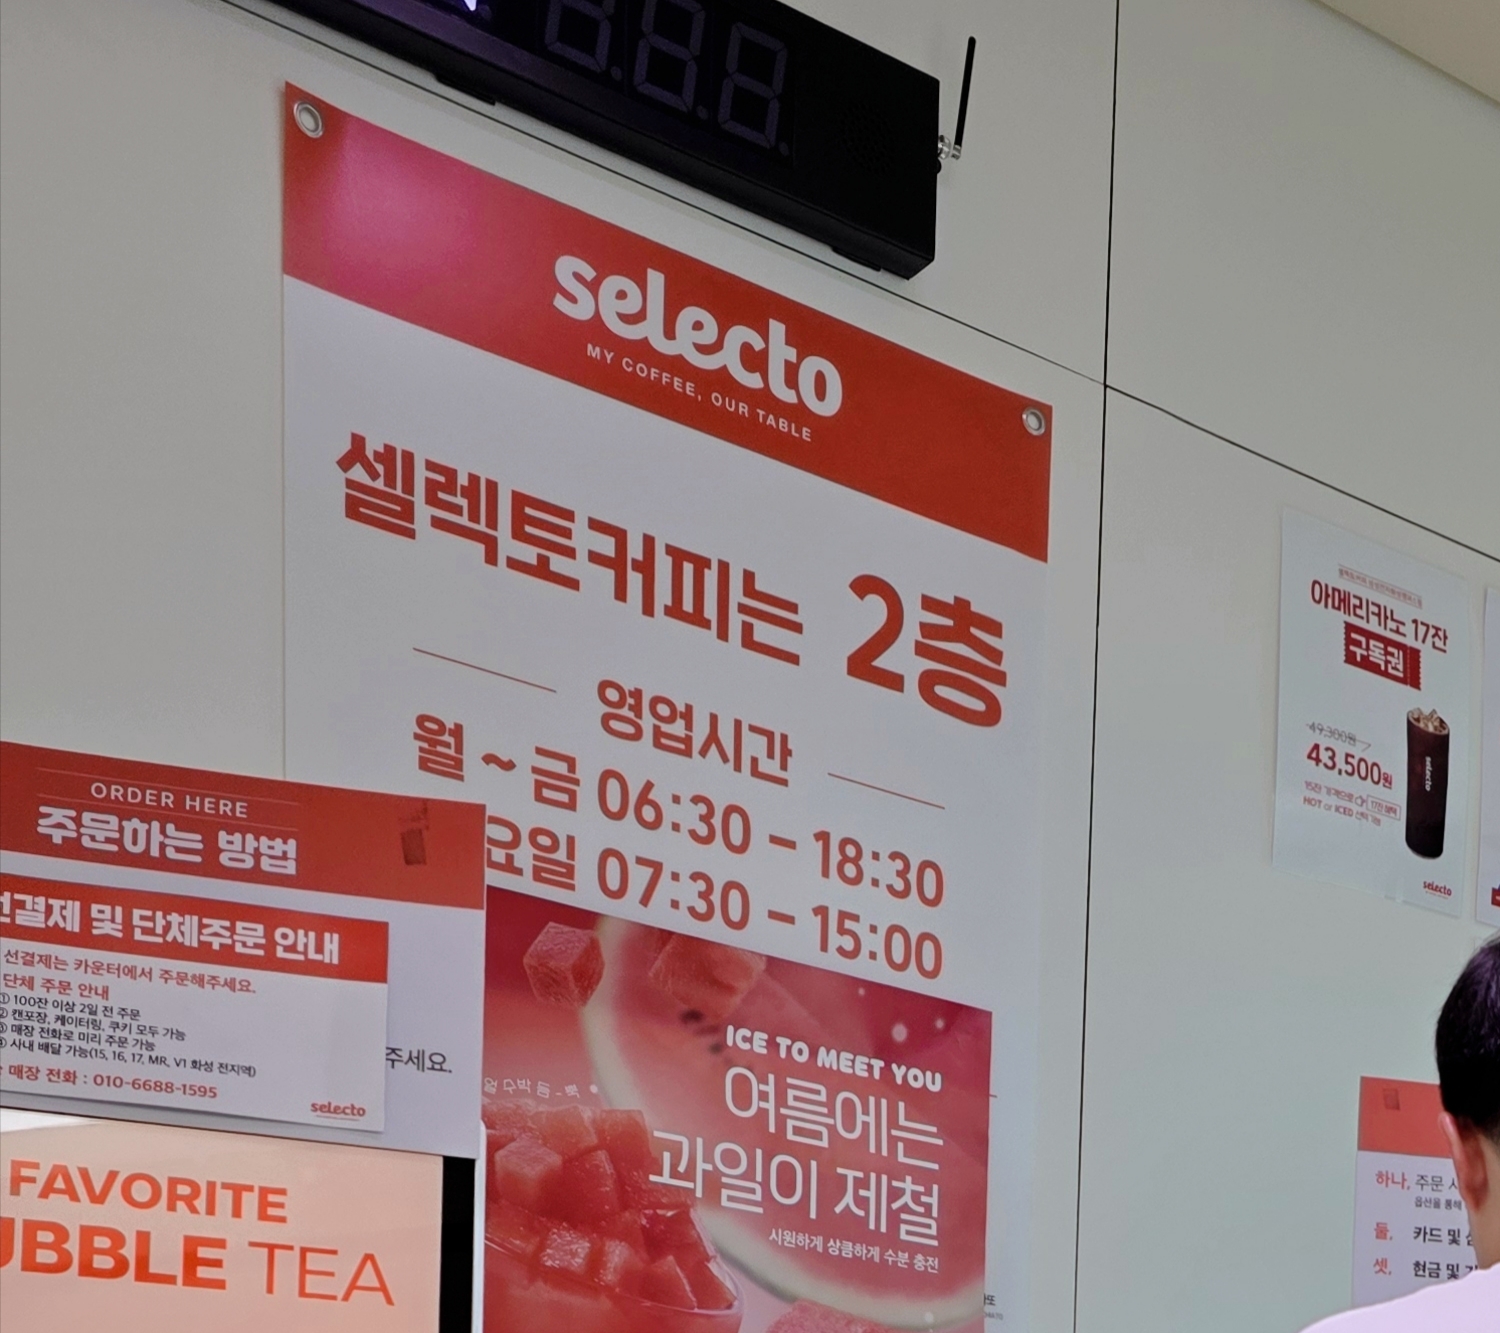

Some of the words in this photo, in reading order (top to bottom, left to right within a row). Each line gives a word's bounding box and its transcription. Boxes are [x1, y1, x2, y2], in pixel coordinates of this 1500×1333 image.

[553, 254, 843, 417] selecto
[587, 343, 615, 364] MY
[622, 356, 702, 402] COFFEE,
[711, 392, 749, 418] OUR
[757, 408, 812, 442] TABLE
[337, 431, 803, 667] 셀렉토커피는
[846, 573, 1007, 728] 2층
[1311, 579, 1407, 638] 아메리카노
[1411, 618, 1448, 653] 17잔
[1349, 632, 1404, 678] 구독권
[597, 679, 792, 787] 영업시간
[1306, 742, 1393, 790] 43,500원
[91, 782, 174, 808] ORDER
[185, 795, 248, 818] HERE
[37, 806, 204, 863] 주문하는
[218, 830, 297, 875] 방법
[597, 769, 752, 855] 06:30
[812, 829, 944, 908] 18:30
[1423, 880, 1452, 896] selecto
[90, 903, 123, 938] 및
[131, 908, 267, 957] 단체주문
[274, 927, 340, 966] 안내
[596, 848, 750, 931] 07:30
[812, 904, 943, 980] 15:00
[3, 973, 34, 991] 단체
[40, 978, 72, 994] 주문
[78, 983, 109, 1001] 안내
[4, 949, 69, 971] 선결제는
[74, 958, 153, 982] 카운터에서
[158, 968, 256, 994] 주문해주세요.
[13, 994, 48, 1010] 100잔
[52, 999, 76, 1014] 이상
[79, 1002, 98, 1017] 2일
[102, 1005, 114, 1018] 전
[117, 1007, 141, 1021] 주문
[10, 1024, 34, 1038] 매장
[39, 1027, 74, 1042] 전화로
[78, 1032, 101, 1046] 미리
[105, 1034, 129, 1048] 주문
[132, 1038, 156, 1052] 가능
[10, 1038, 34, 1053] 사내
[38, 1042, 62, 1055] 배달
[112, 1050, 127, 1063] 16,
[190, 1059, 214, 1074] 화성
[135, 1024, 159, 1038] 모두
[163, 1027, 186, 1041] 가능
[9, 1064, 40, 1081] 매장
[46, 1068, 76, 1086] 전화
[93, 1074, 217, 1098] 010-6688-1595
[726, 1025, 768, 1056] ICE
[776, 1036, 810, 1064] TO
[816, 1046, 885, 1081] MEET
[891, 1063, 942, 1092] YOU
[311, 1101, 366, 1117] selecto
[724, 1066, 944, 1170] 여름에는
[9, 1159, 288, 1224] FAVORITE
[649, 1128, 819, 1220] 과일이
[834, 1166, 940, 1247] 제철
[1375, 1170, 1411, 1191] 하나,
[1415, 1174, 1444, 1193] 주문
[769, 1228, 823, 1252] 시원하게
[827, 1238, 880, 1263] 상큼하게
[884, 1249, 909, 1268] 수분
[913, 1254, 938, 1273] 충전
[1374, 1222, 1393, 1241] 둘,
[1413, 1226, 1443, 1244] 카드
[1447, 1228, 1461, 1246] 및
[248, 1240, 395, 1307] TEA
[1373, 1257, 1392, 1276] 셋,
[1413, 1260, 1441, 1279] 현금
[1446, 1262, 1460, 1280] 및
